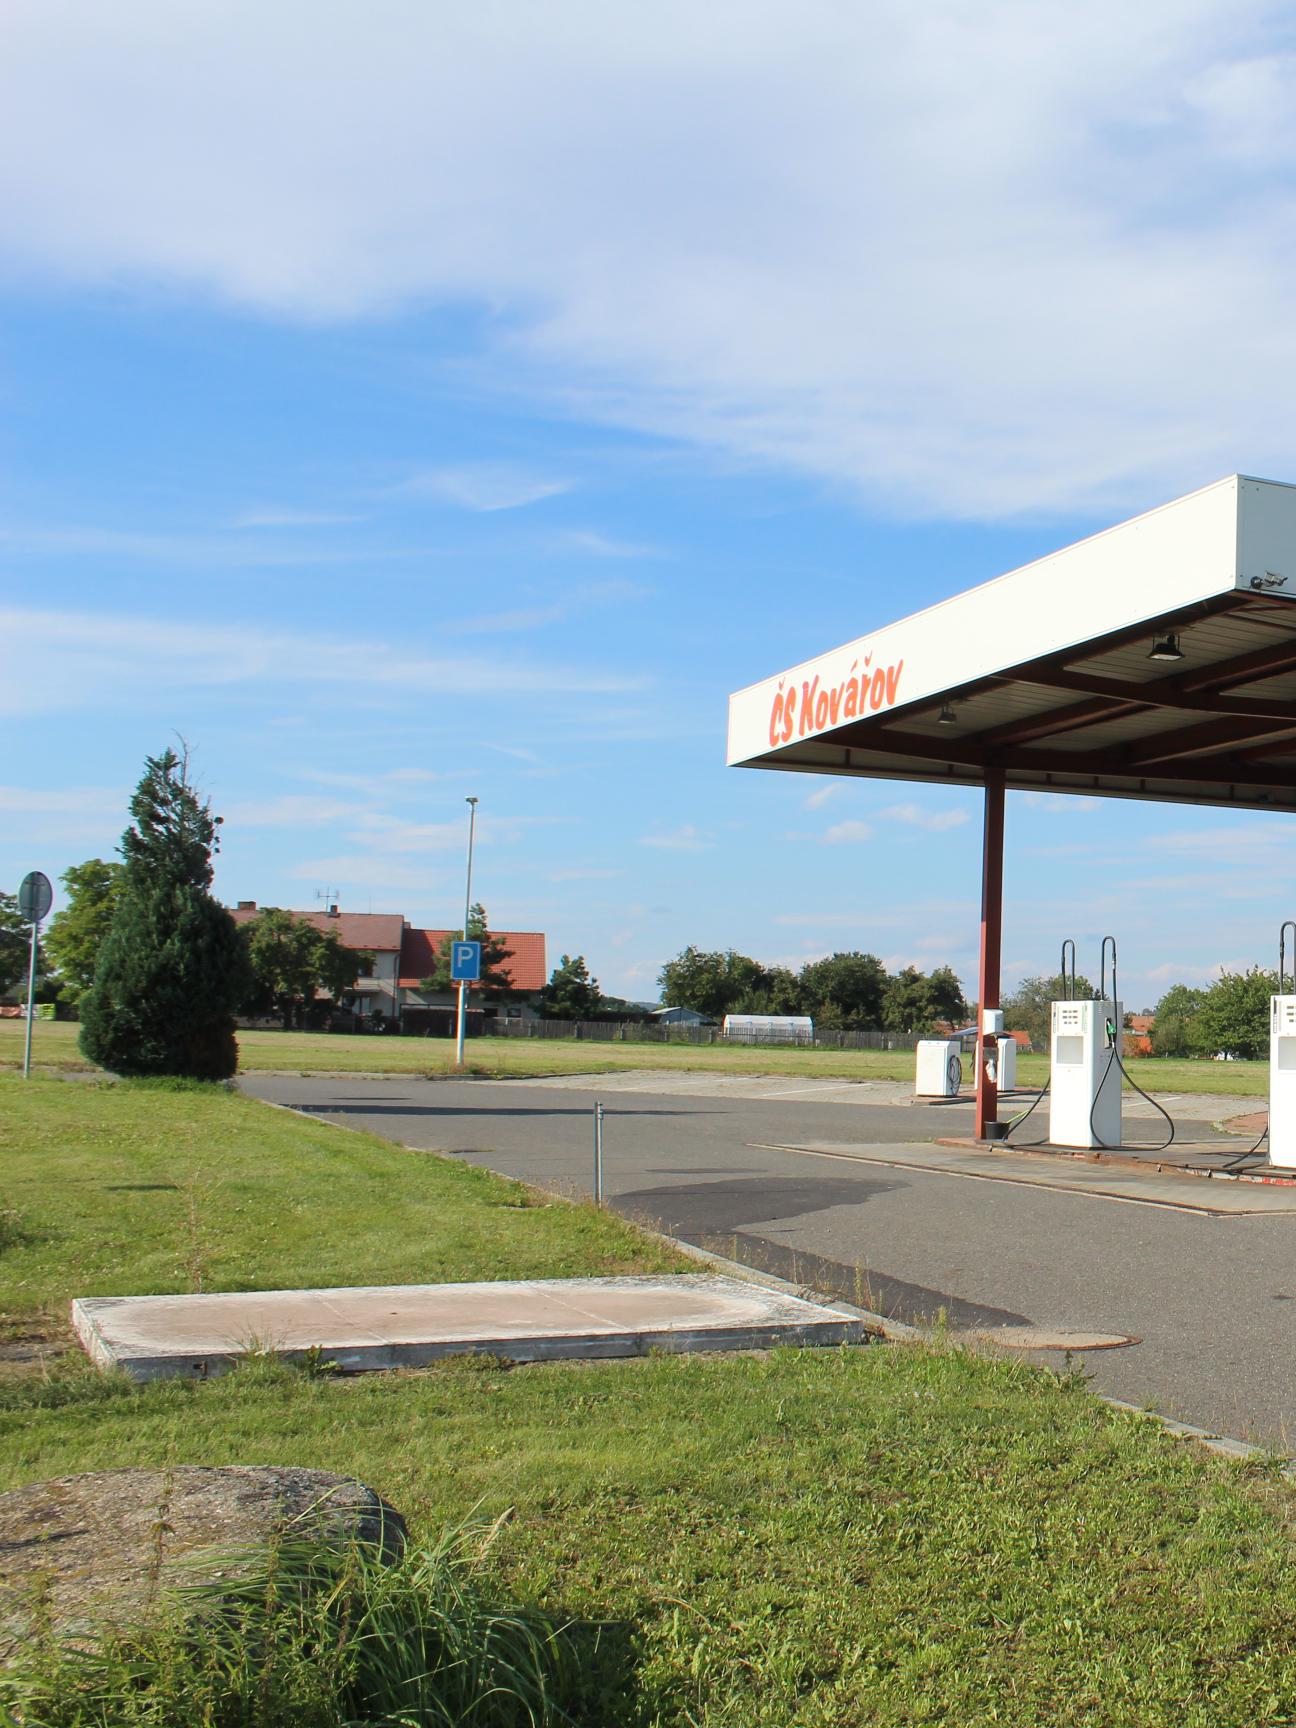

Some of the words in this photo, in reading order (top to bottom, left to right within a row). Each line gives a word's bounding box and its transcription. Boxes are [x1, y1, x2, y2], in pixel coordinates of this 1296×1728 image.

[769, 676, 797, 747] ČS
[798, 650, 904, 736] Kovářov
[457, 946, 474, 968] P
